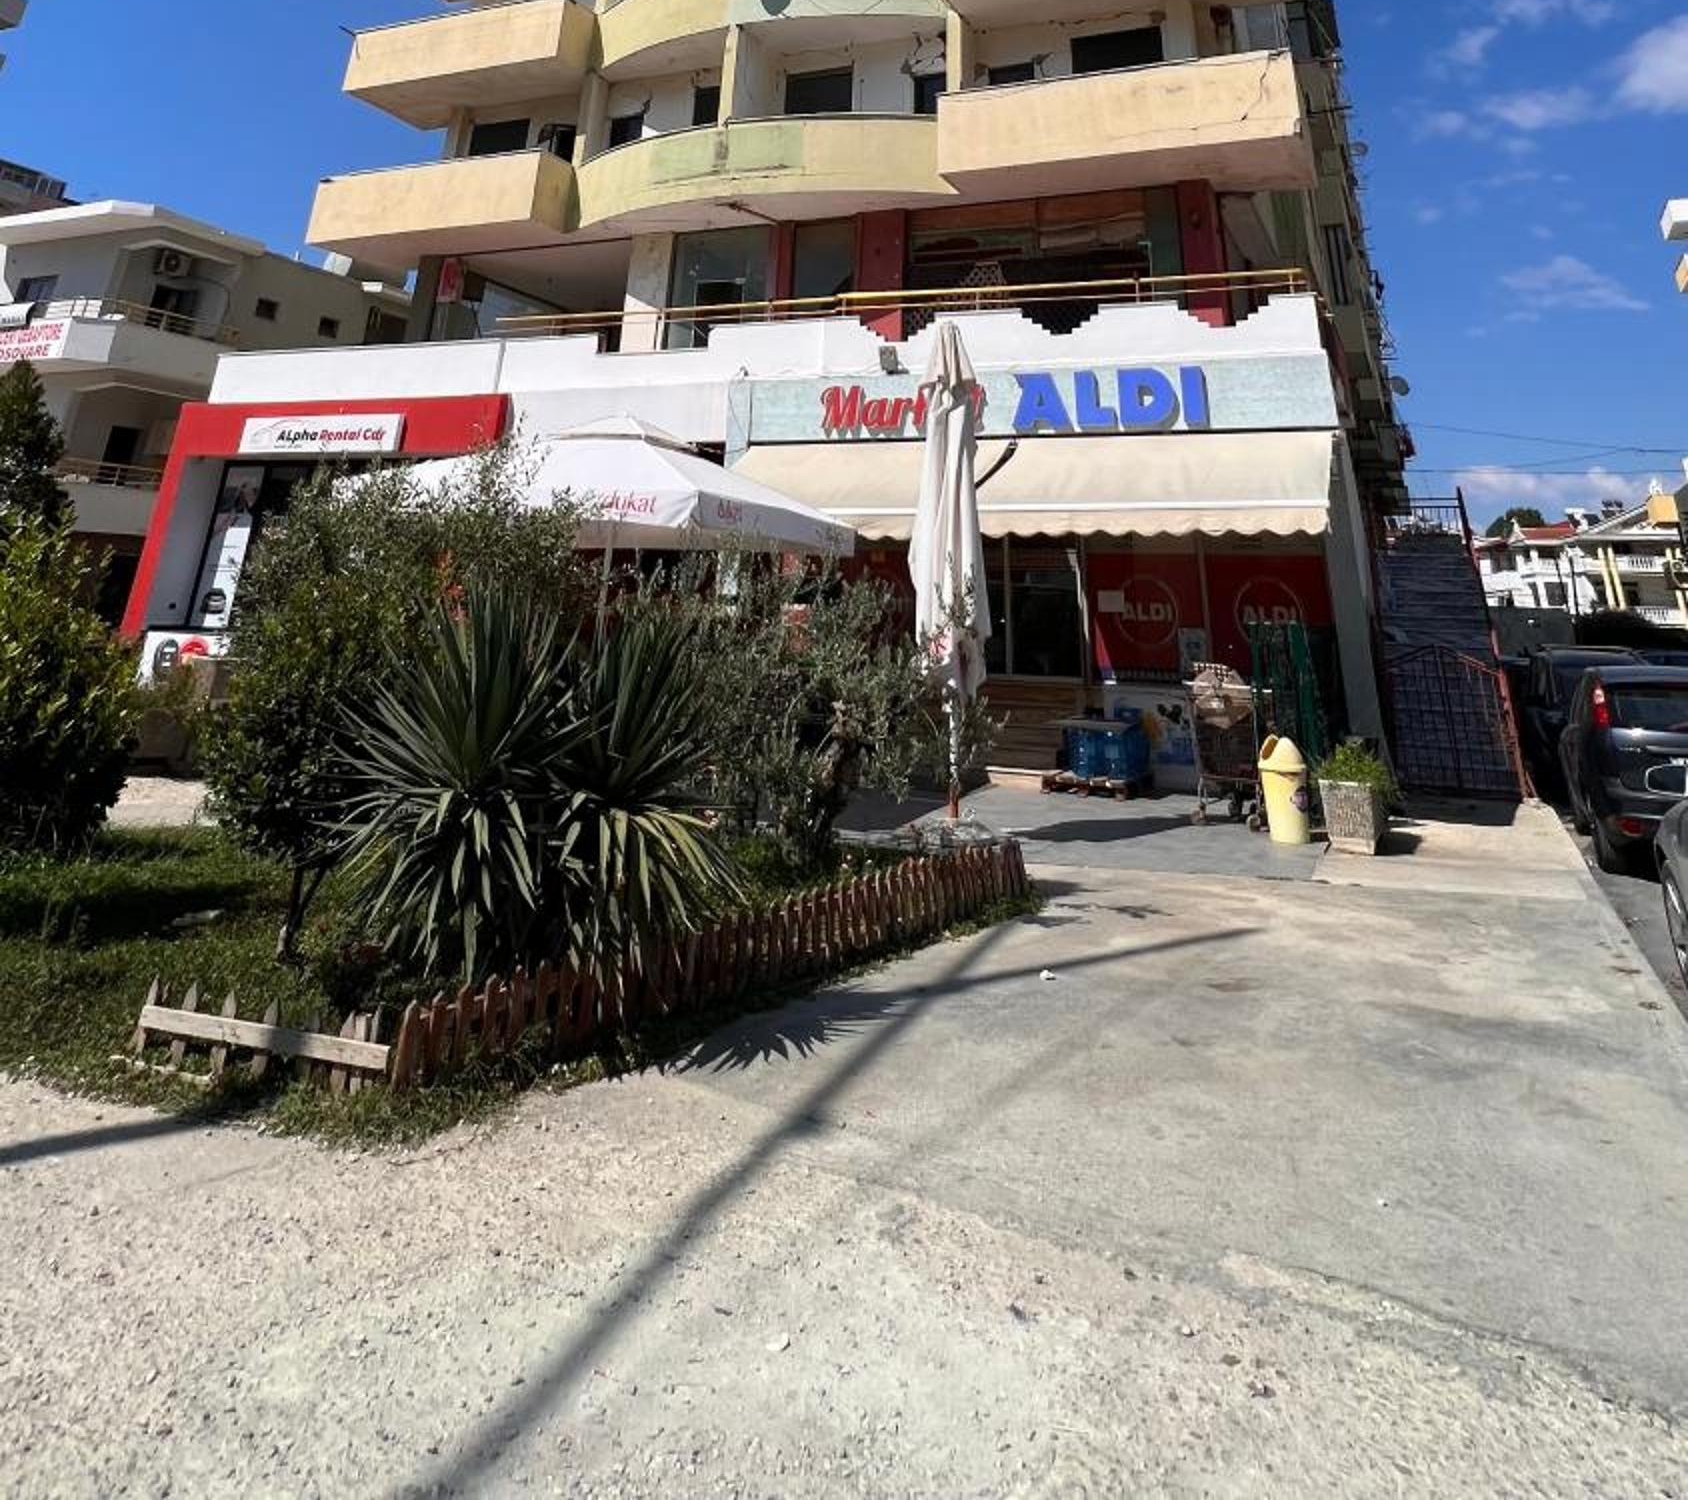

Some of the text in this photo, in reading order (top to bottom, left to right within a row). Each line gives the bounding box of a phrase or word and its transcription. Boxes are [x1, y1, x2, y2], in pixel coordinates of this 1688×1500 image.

[1012, 365, 1209, 431] ALDI
[319, 428, 362, 441] Rental
[1121, 602, 1174, 622] ALDI
